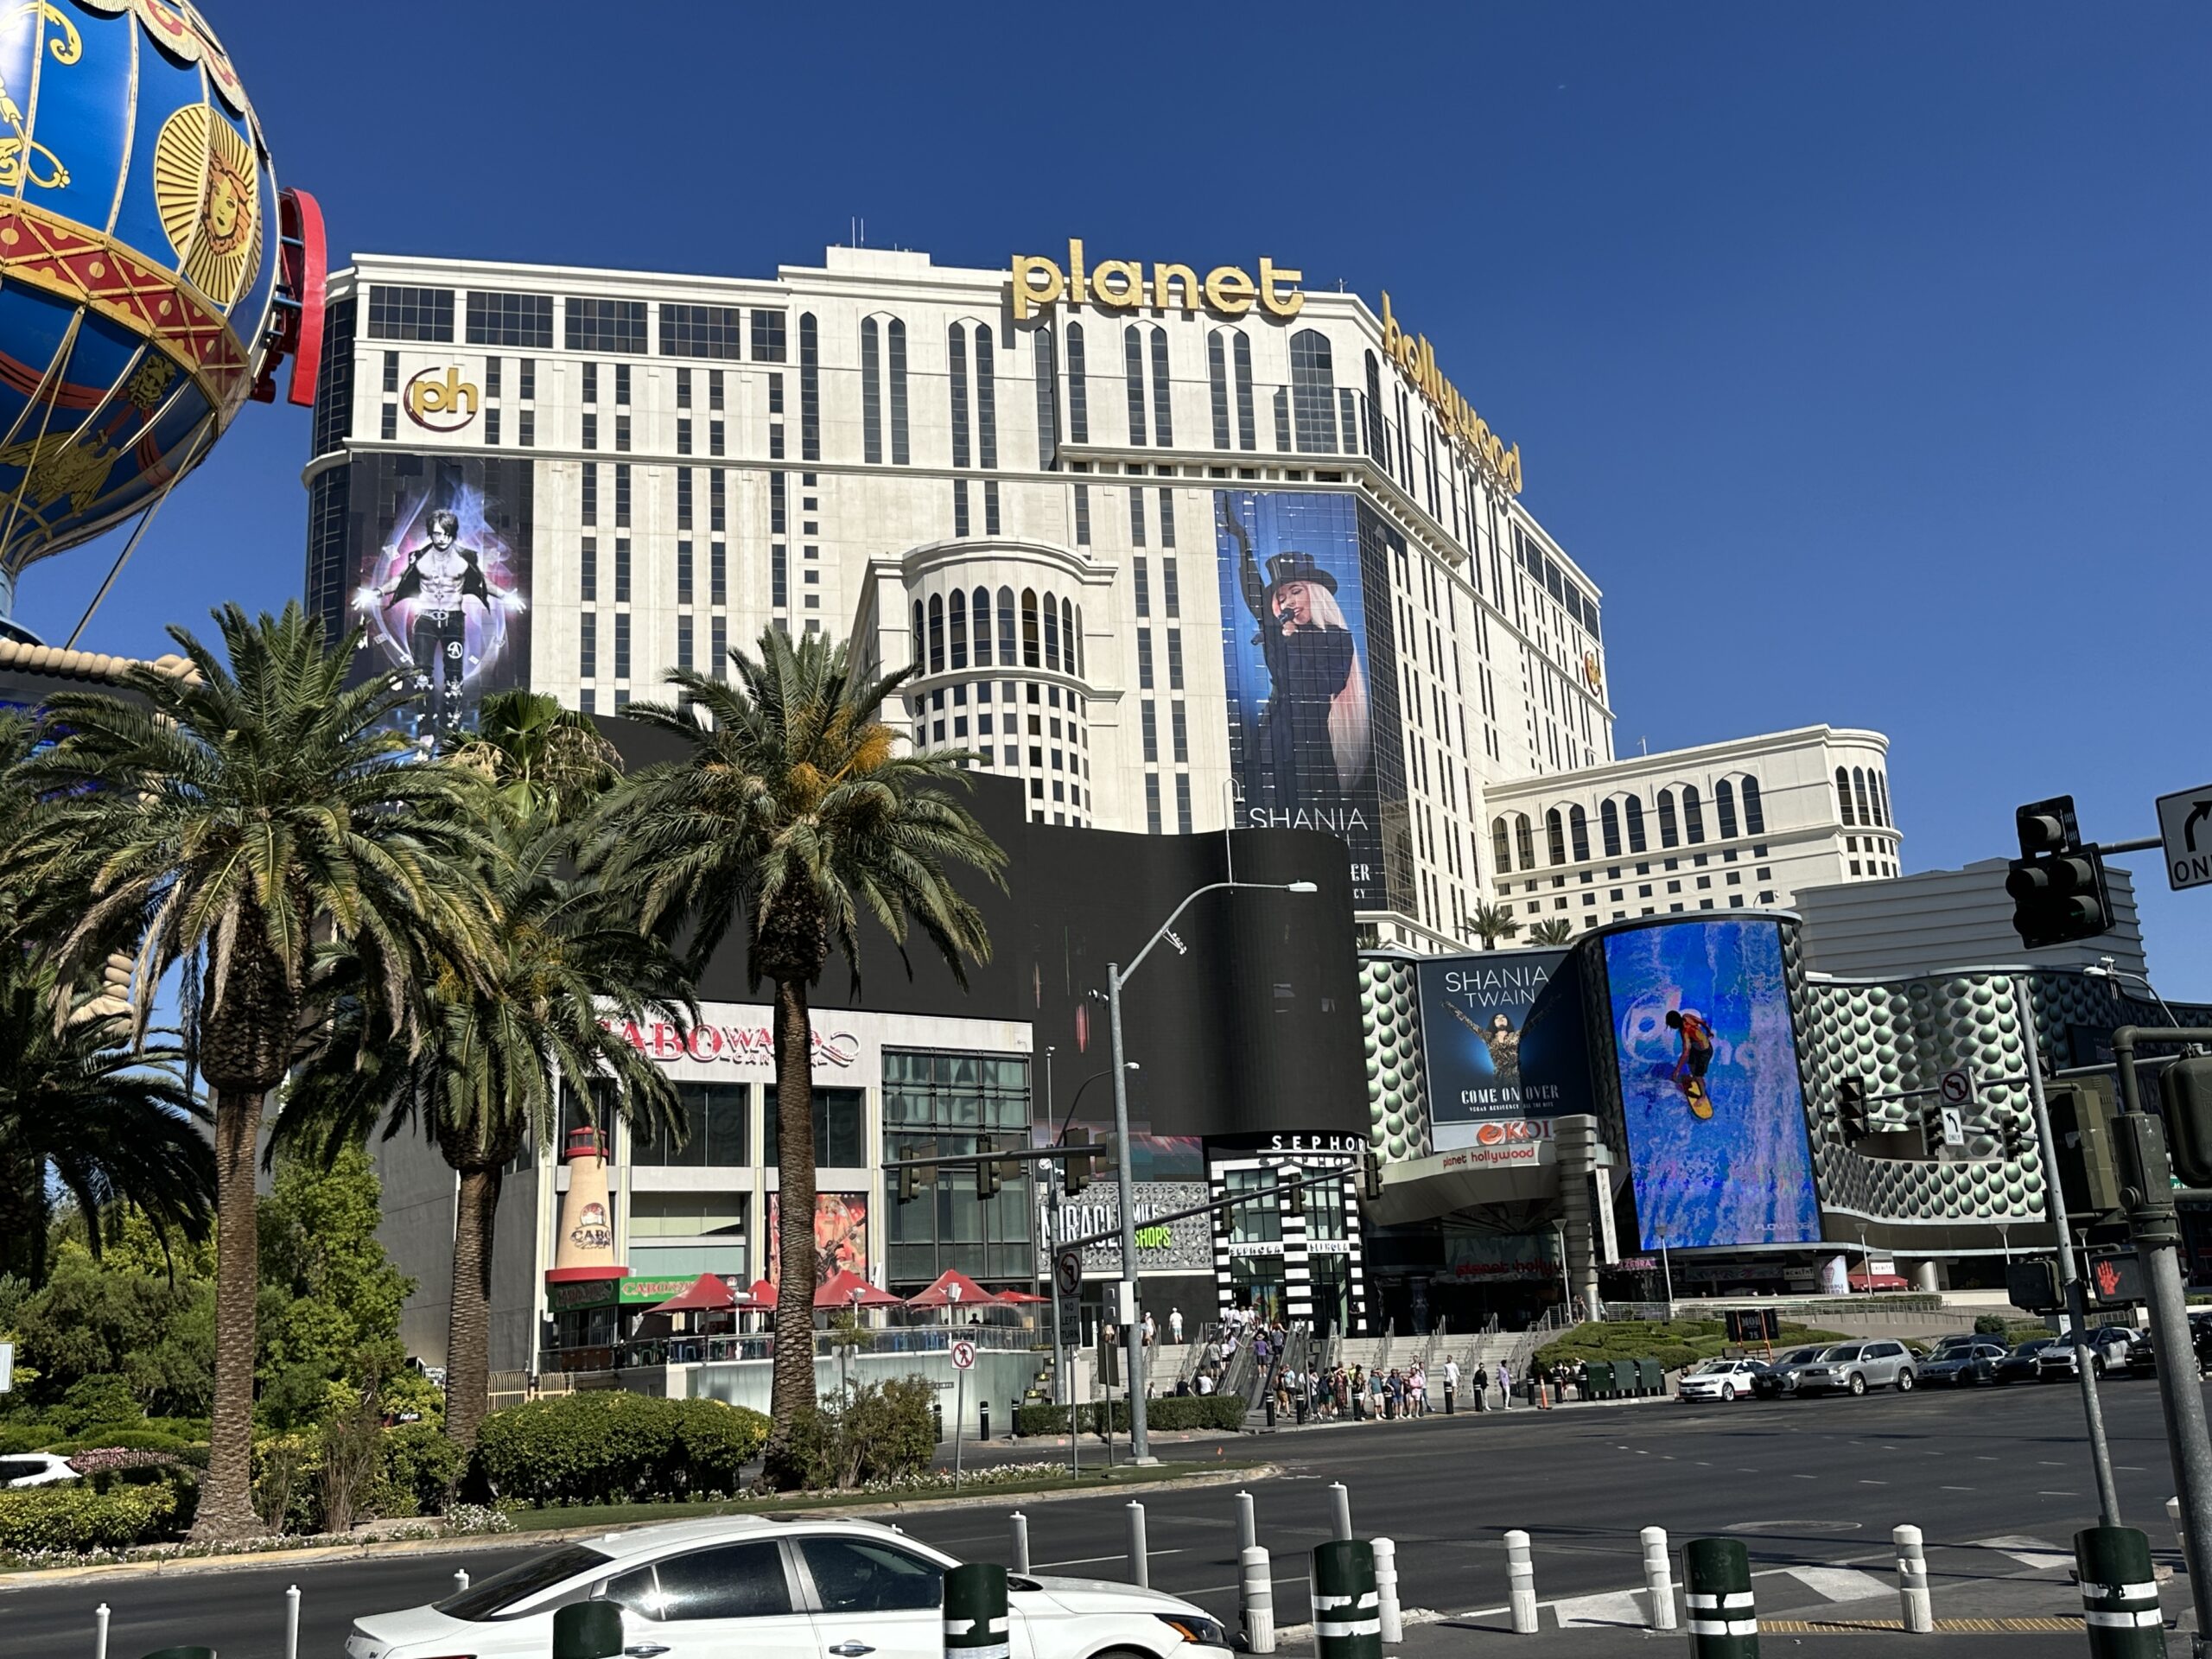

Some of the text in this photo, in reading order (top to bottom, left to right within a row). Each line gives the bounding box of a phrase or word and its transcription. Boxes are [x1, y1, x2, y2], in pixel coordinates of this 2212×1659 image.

[1012, 238, 1305, 321] planet
[413, 367, 479, 422] ph
[1382, 289, 1522, 494] hollywood
[1249, 807, 1369, 831] SHANIA
[1351, 864, 1370, 881] ER
[2173, 855, 2212, 882] ON
[1445, 965, 1549, 993] SHANIA
[1464, 988, 1535, 1008] TWAIN
[596, 1019, 722, 1062] ABO
[1461, 1084, 1560, 1105] COME ON OVER
[1506, 1120, 1553, 1141] KOI
[1442, 1147, 1535, 1168] planet hollywood
[1135, 1226, 1172, 1249] SHOPS
[622, 1282, 669, 1297] CABO
[1064, 1302, 1075, 1312] NO
[1061, 1316, 1077, 1325] LEFT
[1061, 1330, 1080, 1340] TURN
